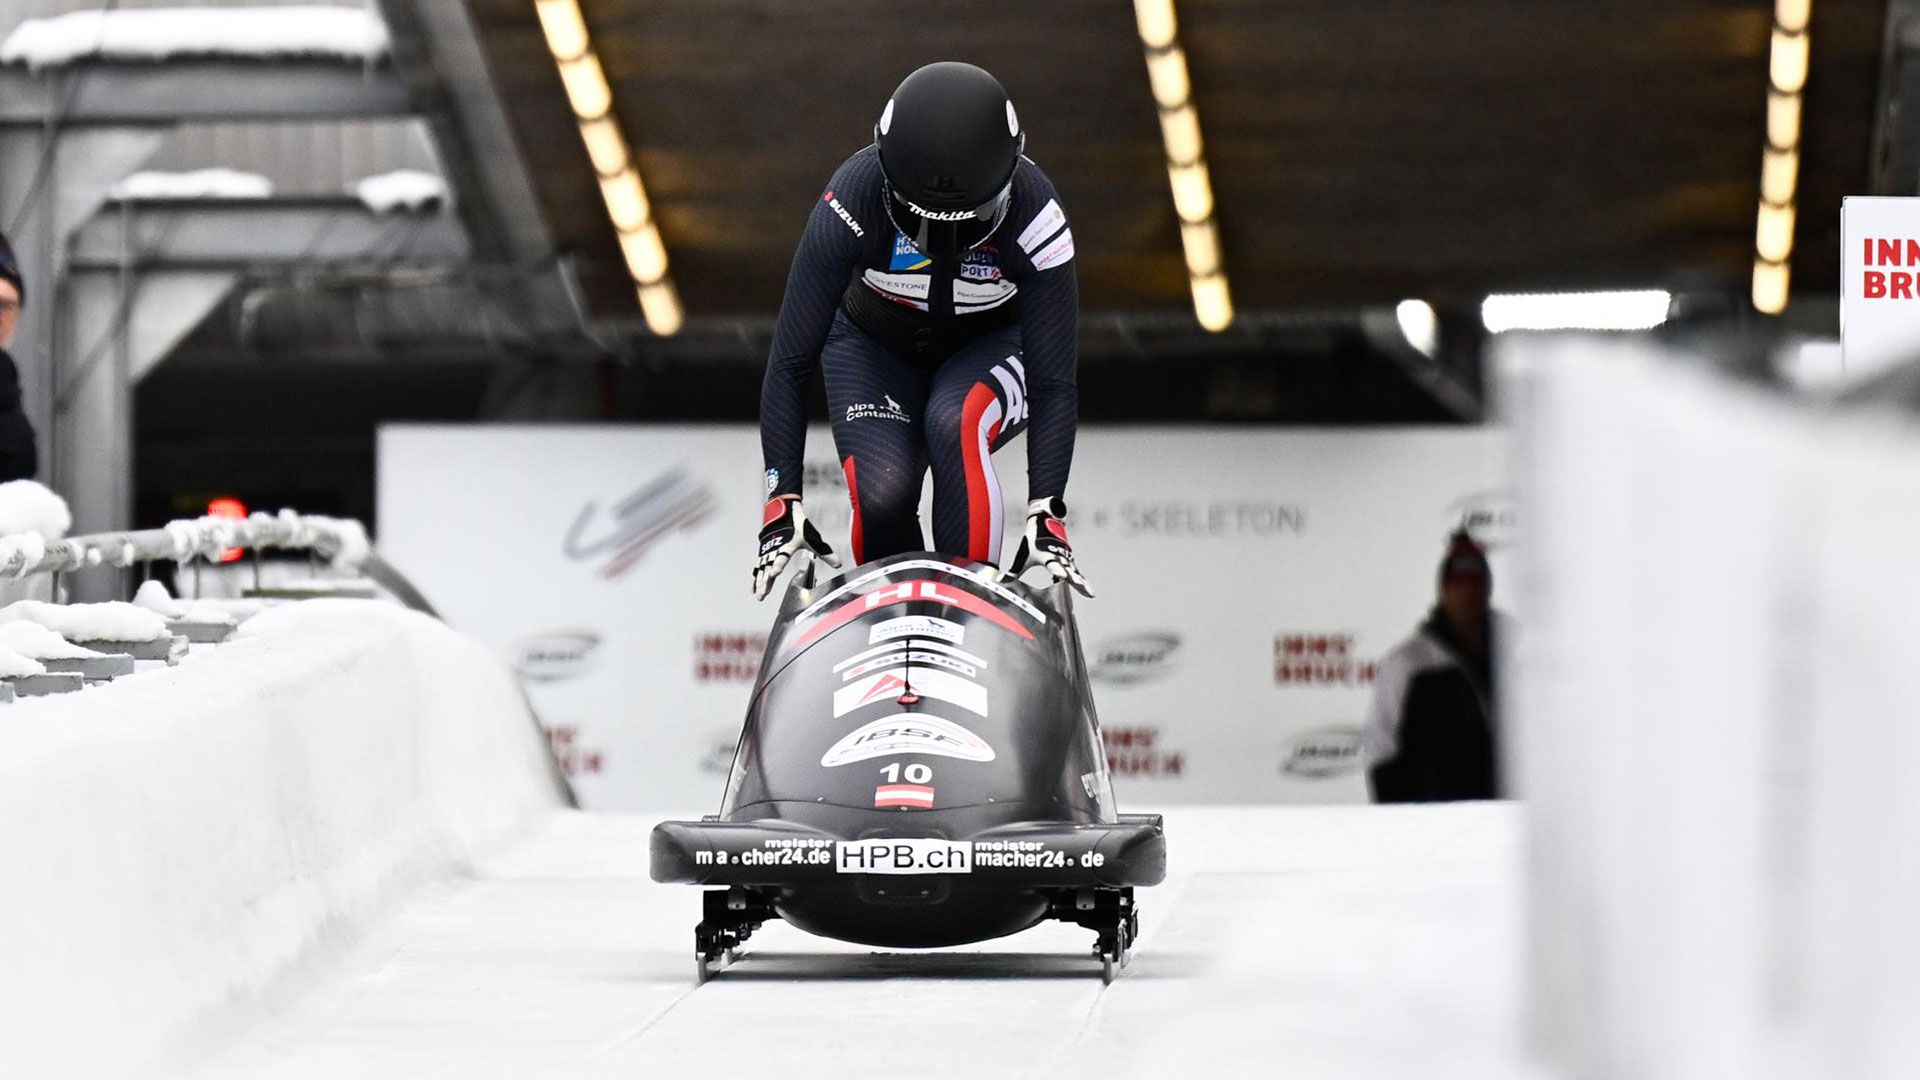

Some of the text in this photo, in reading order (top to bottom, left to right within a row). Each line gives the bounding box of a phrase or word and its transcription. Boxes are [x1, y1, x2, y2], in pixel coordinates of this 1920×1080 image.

[829, 198, 864, 237] SUZUKI
[908, 201, 978, 221] makita
[1863, 271, 1920, 299] BR
[846, 403, 875, 415] Alps
[854, 727, 966, 747] IBSF
[879, 762, 933, 784] 10
[764, 838, 832, 848] meister
[975, 840, 1045, 851] meister
[843, 845, 965, 868] HPB.ch
